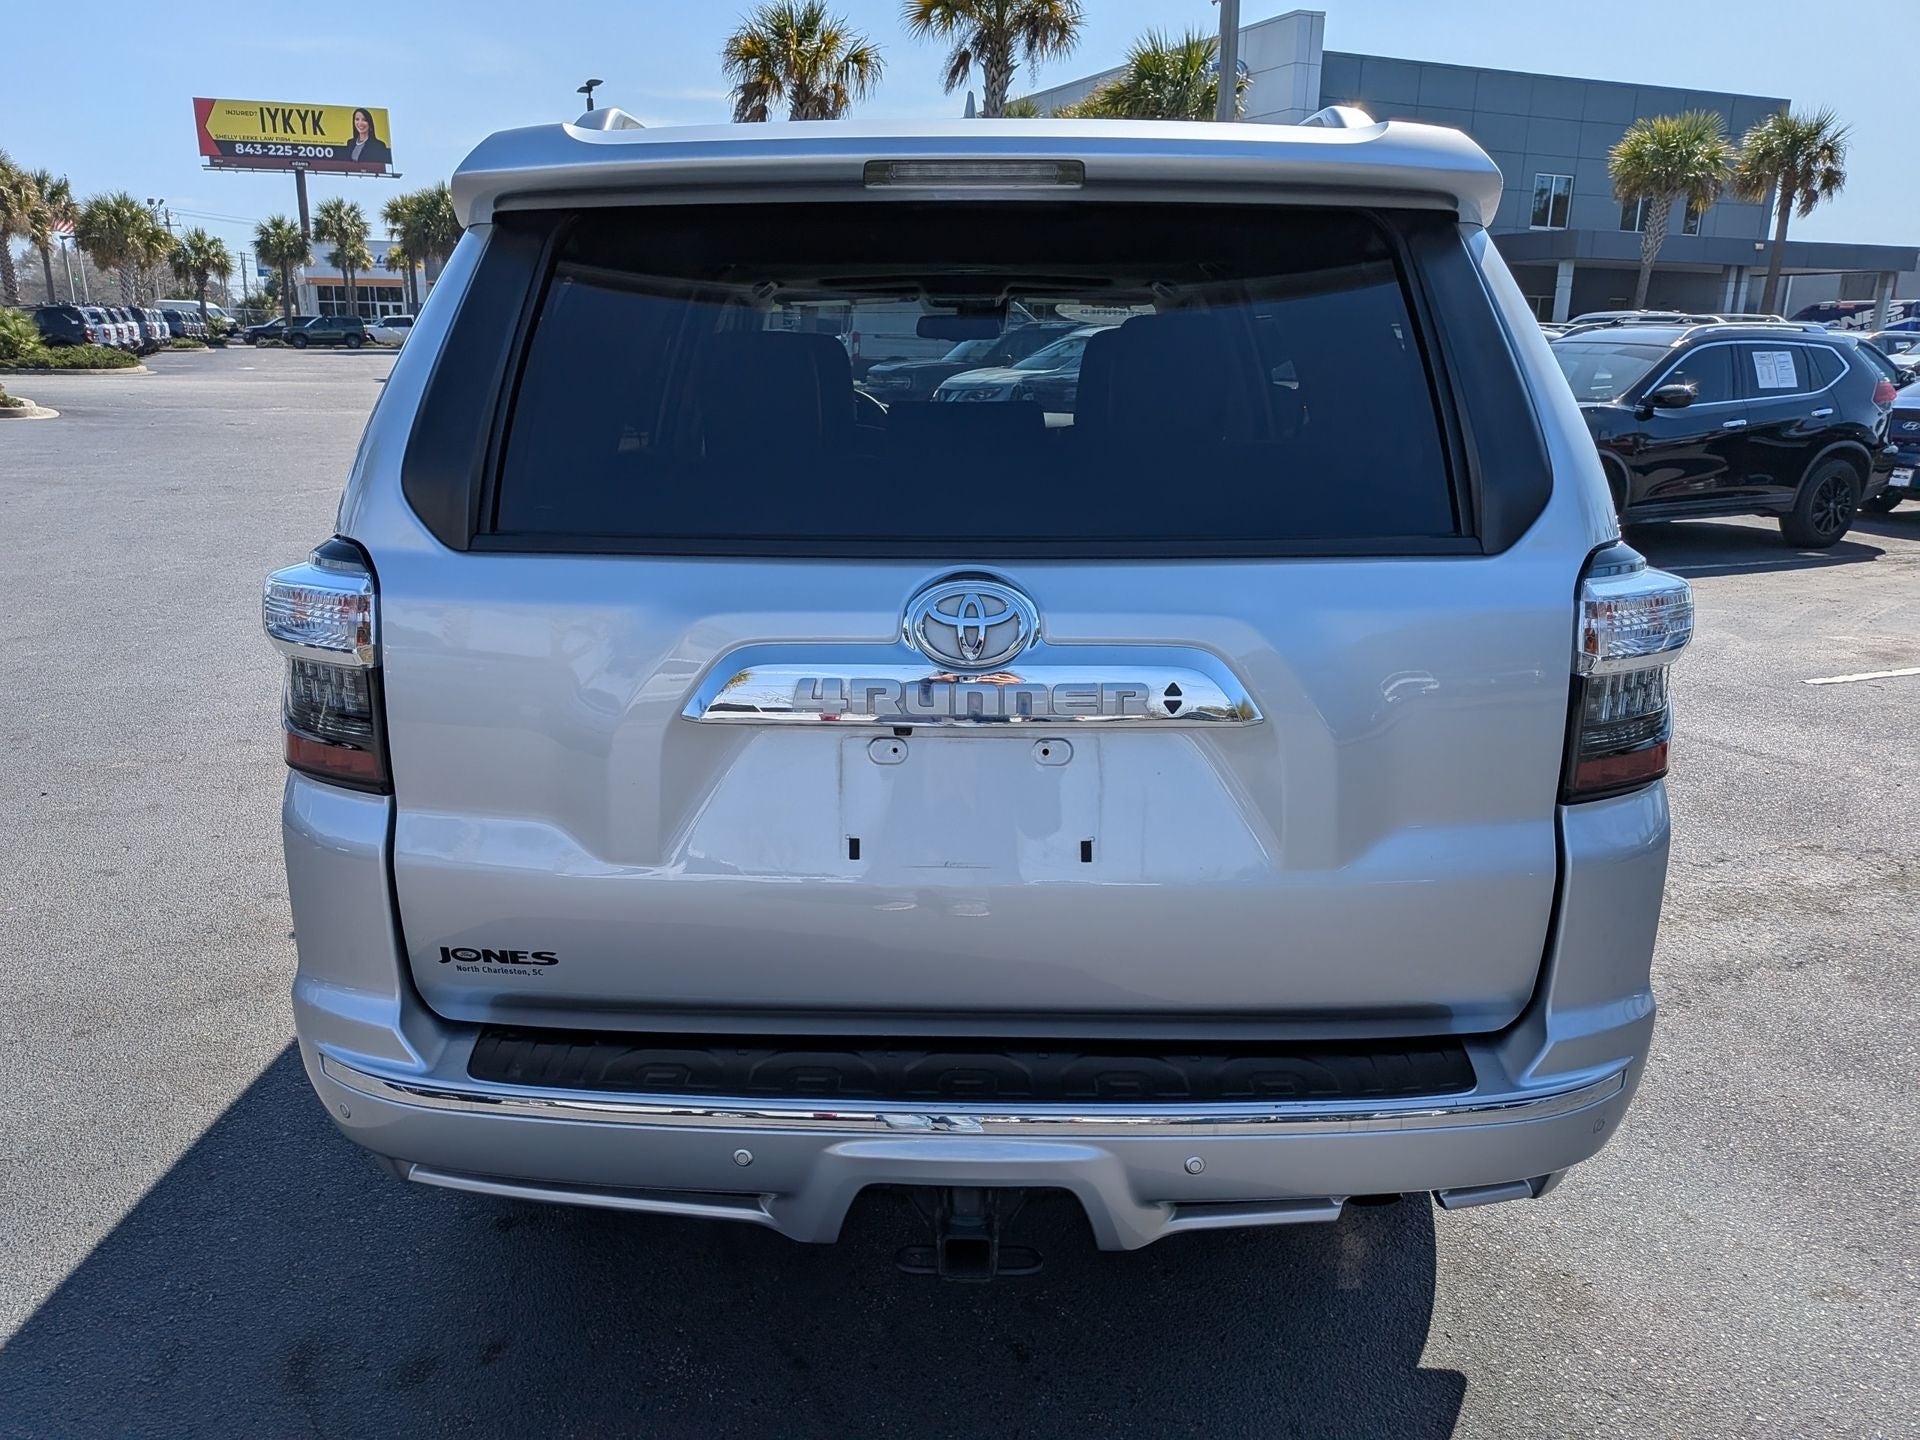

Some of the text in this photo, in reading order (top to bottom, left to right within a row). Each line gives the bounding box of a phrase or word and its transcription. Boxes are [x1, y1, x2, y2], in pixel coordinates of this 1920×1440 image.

[225, 109, 257, 117] INJURED?
[259, 106, 326, 136] IYKYK
[235, 143, 334, 158] 843-225-2000
[794, 677, 1151, 716] 4RUNNER
[438, 946, 559, 966] JONES
[456, 964, 544, 976] North Charleston, SC
